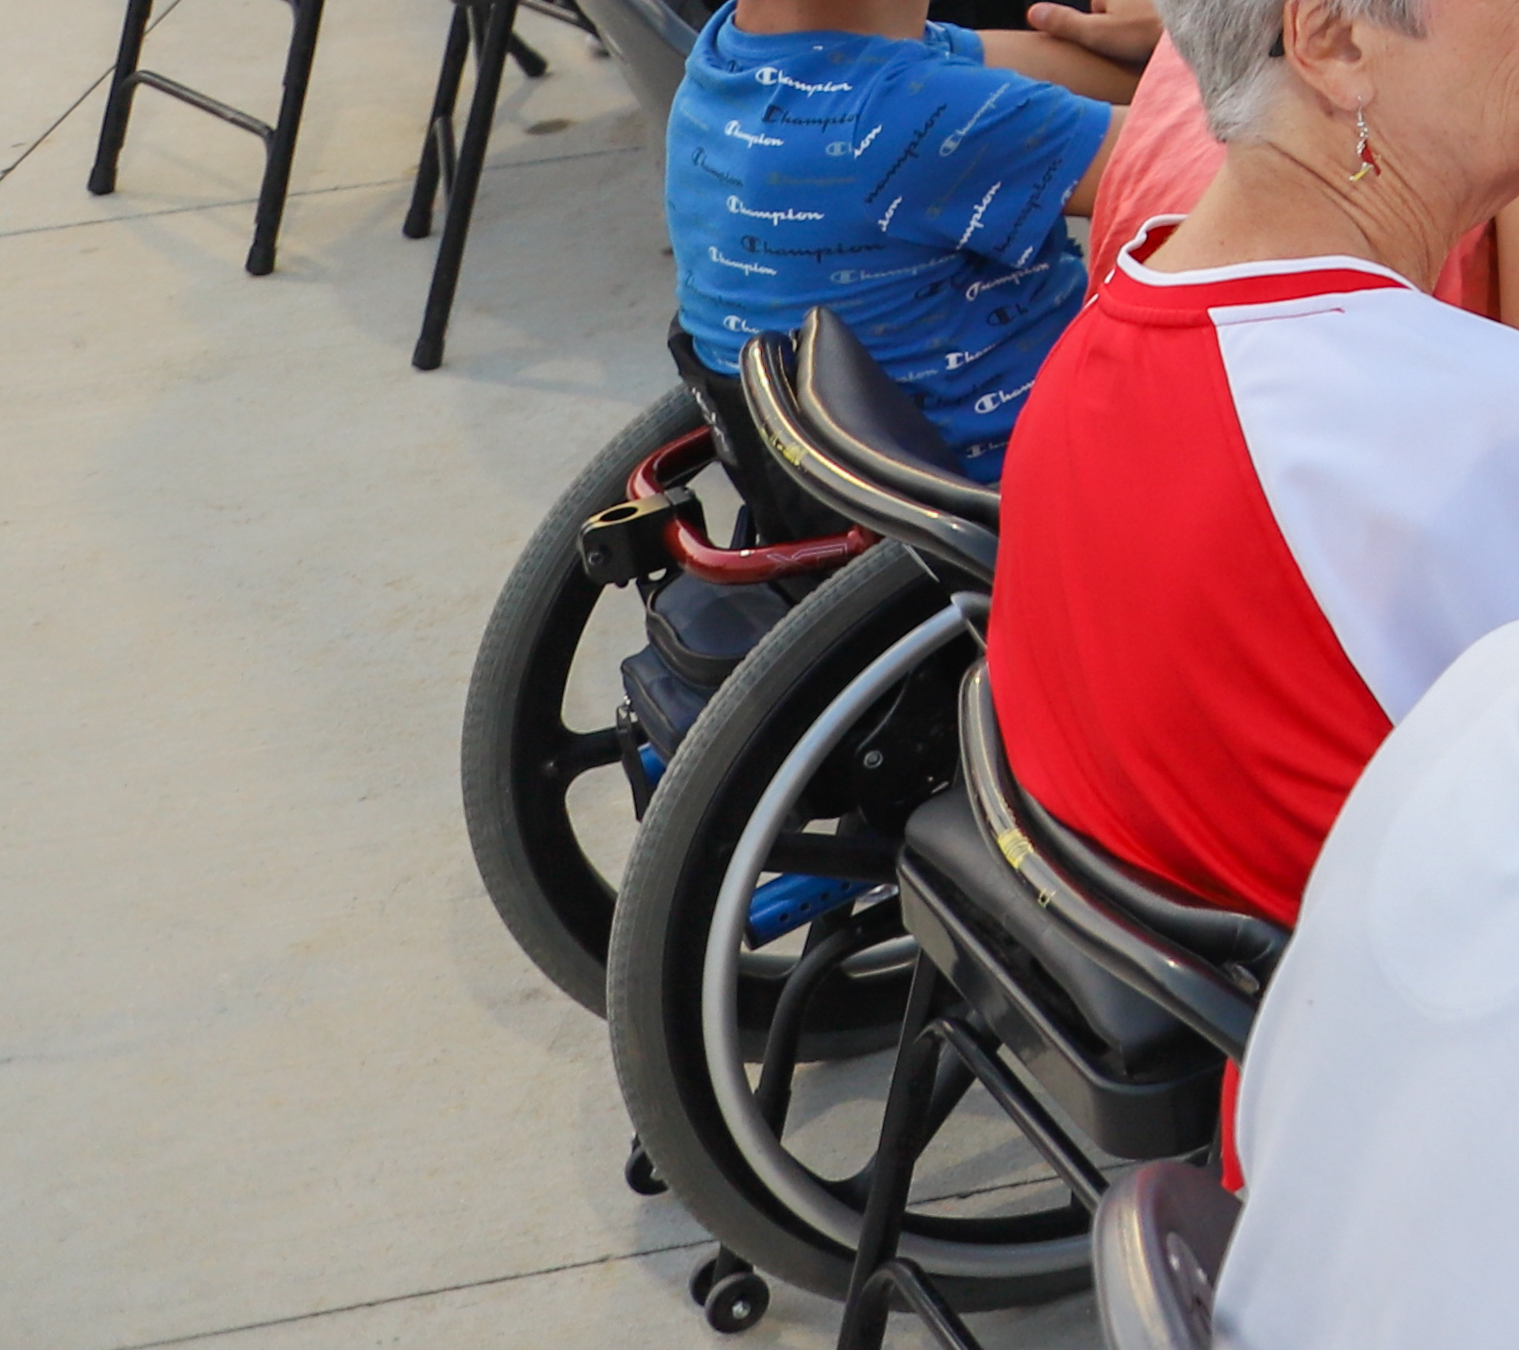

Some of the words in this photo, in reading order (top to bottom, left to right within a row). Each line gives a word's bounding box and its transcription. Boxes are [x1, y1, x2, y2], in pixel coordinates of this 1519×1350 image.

[755, 66, 853, 98] Champion
[761, 104, 859, 133] Champio
[727, 195, 825, 227] Champion
